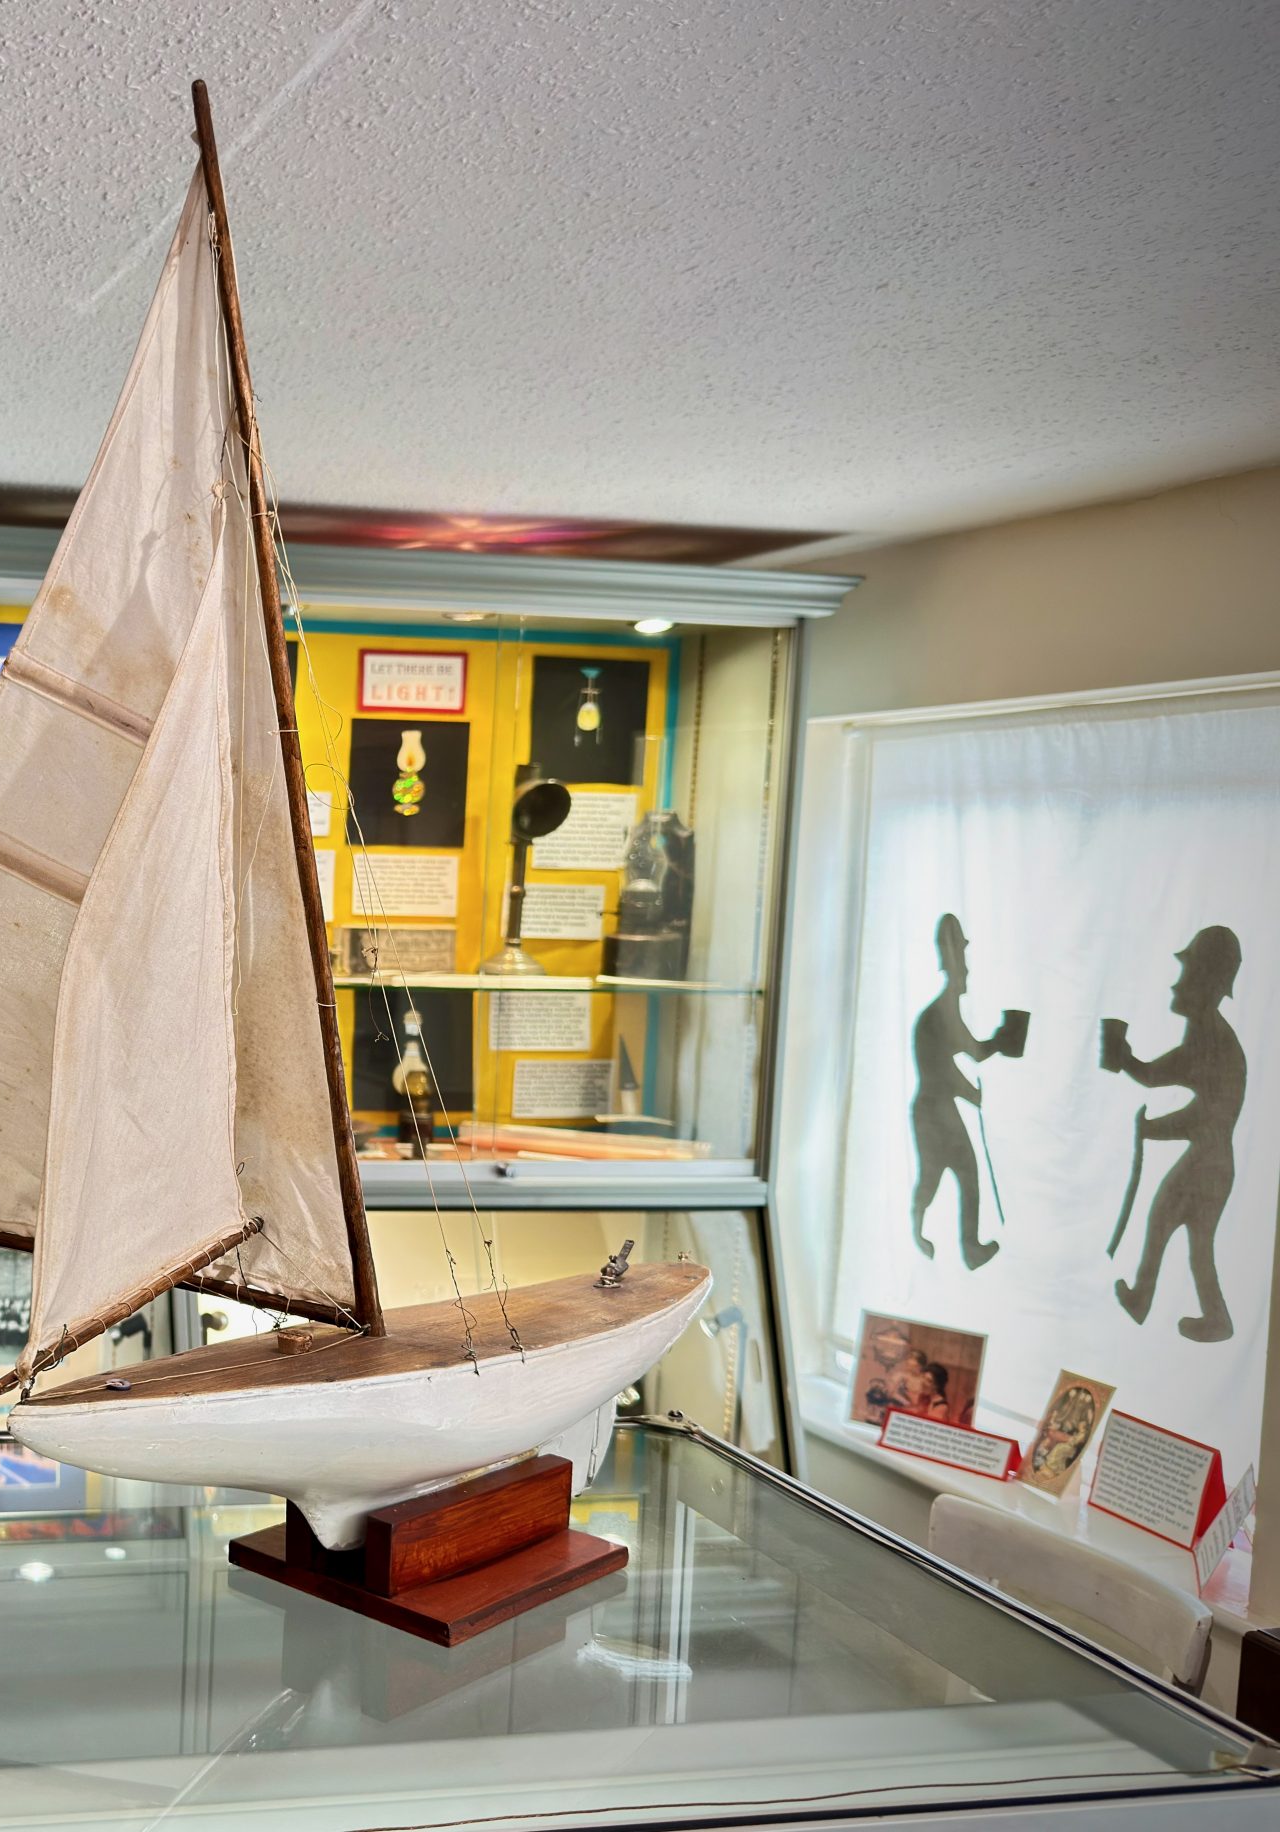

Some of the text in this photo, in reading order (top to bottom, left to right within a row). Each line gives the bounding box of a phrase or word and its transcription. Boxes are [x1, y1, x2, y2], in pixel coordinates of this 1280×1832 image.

[370, 662, 453, 675] LET THERE BE
[371, 684, 455, 702] LIGHT!
